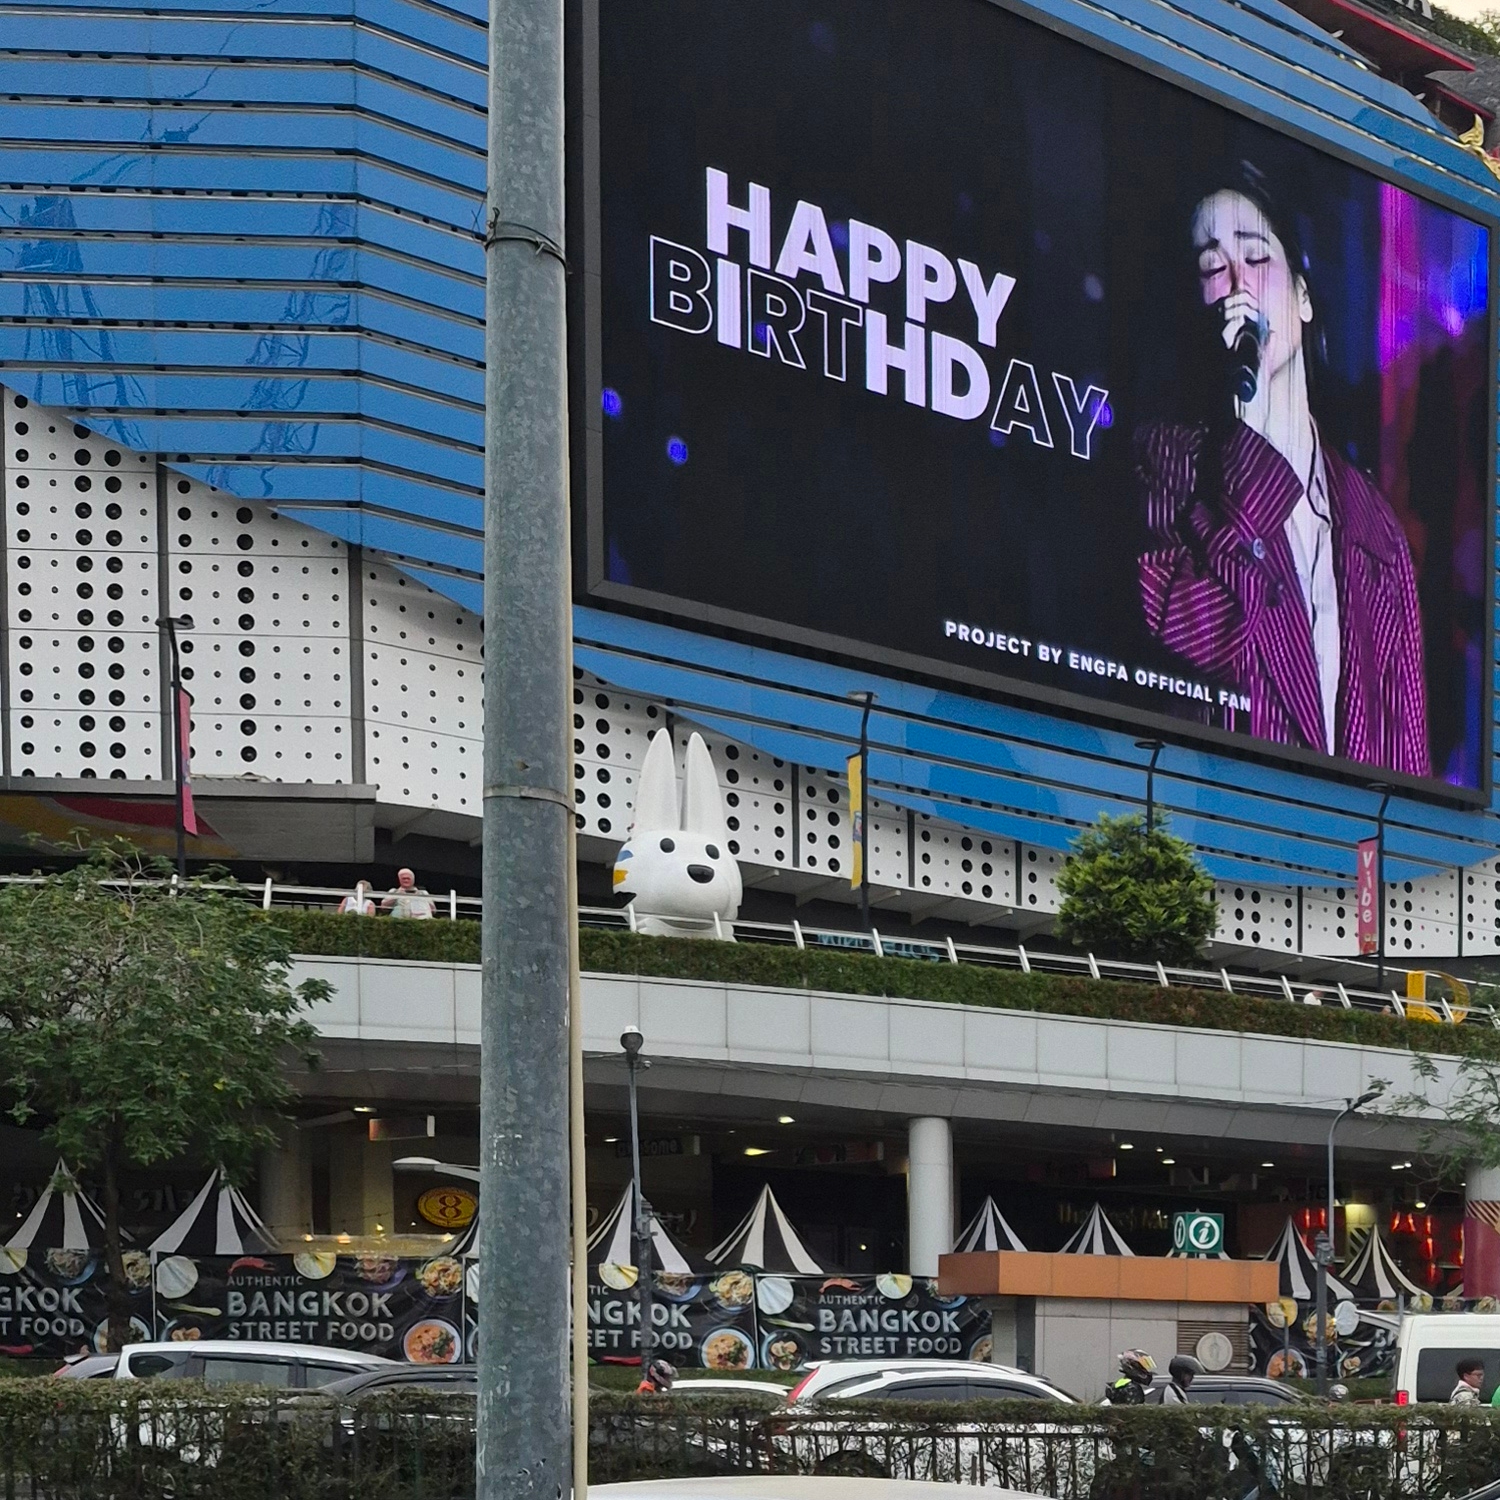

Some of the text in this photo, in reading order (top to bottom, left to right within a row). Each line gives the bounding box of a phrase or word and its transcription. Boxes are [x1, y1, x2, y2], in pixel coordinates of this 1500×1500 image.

[706, 166, 1016, 348] HAPPY
[650, 235, 1109, 460] BIRTHDAY
[944, 620, 1251, 714] PROJECT BY ENGFA OFFICIAL FAN
[1361, 850, 1374, 924] Vibe
[226, 1275, 304, 1287] AUTHENTIC
[227, 1290, 394, 1318] BANGKOK
[818, 1295, 886, 1305] AUTHENTIC
[20, 1317, 85, 1337] FOOD
[227, 1321, 395, 1342] STREET FOOD
[818, 1308, 962, 1333] BANGKOK
[820, 1336, 963, 1355] STREET FOOD
